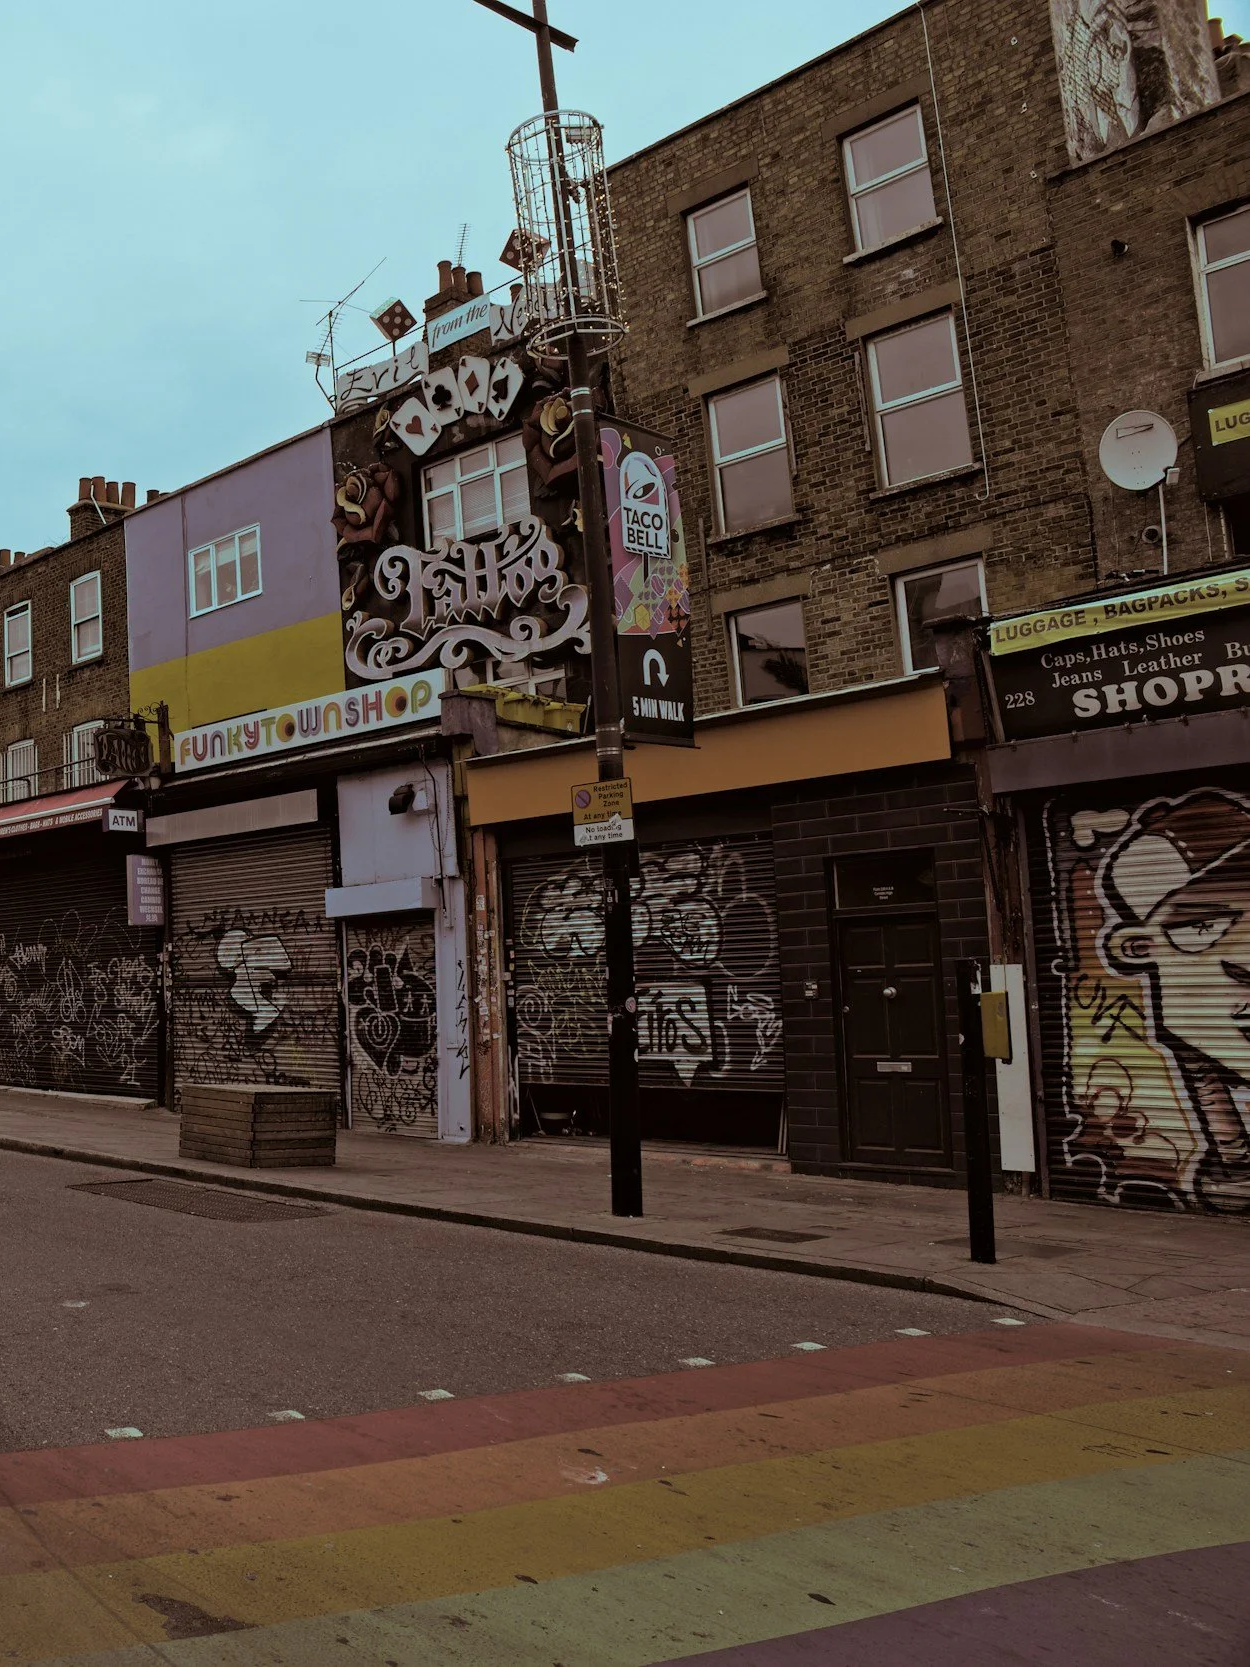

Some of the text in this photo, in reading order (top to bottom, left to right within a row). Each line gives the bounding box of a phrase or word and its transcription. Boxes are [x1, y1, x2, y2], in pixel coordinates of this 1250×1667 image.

[432, 303, 488, 347] from the
[340, 345, 420, 396] Evil
[623, 507, 663, 532] TACO
[627, 528, 664, 551] BELL
[995, 609, 1086, 644] LUGGAGE
[1104, 581, 1228, 620] BAGPACKS,
[1051, 668, 1103, 689] Jeans
[1123, 652, 1203, 677] Leather
[632, 696, 685, 722] 5 MIN WALK
[1004, 691, 1036, 710] 228
[593, 782, 628, 792] Restricted
[598, 792, 624, 800] Parking
[74, 808, 103, 823] ACCESSORIES
[112, 815, 136, 828] ATM
[141, 886, 161, 894] CHANGE
[139, 905, 163, 913] WECHSEL
[141, 896, 161, 904] CAMBIO
